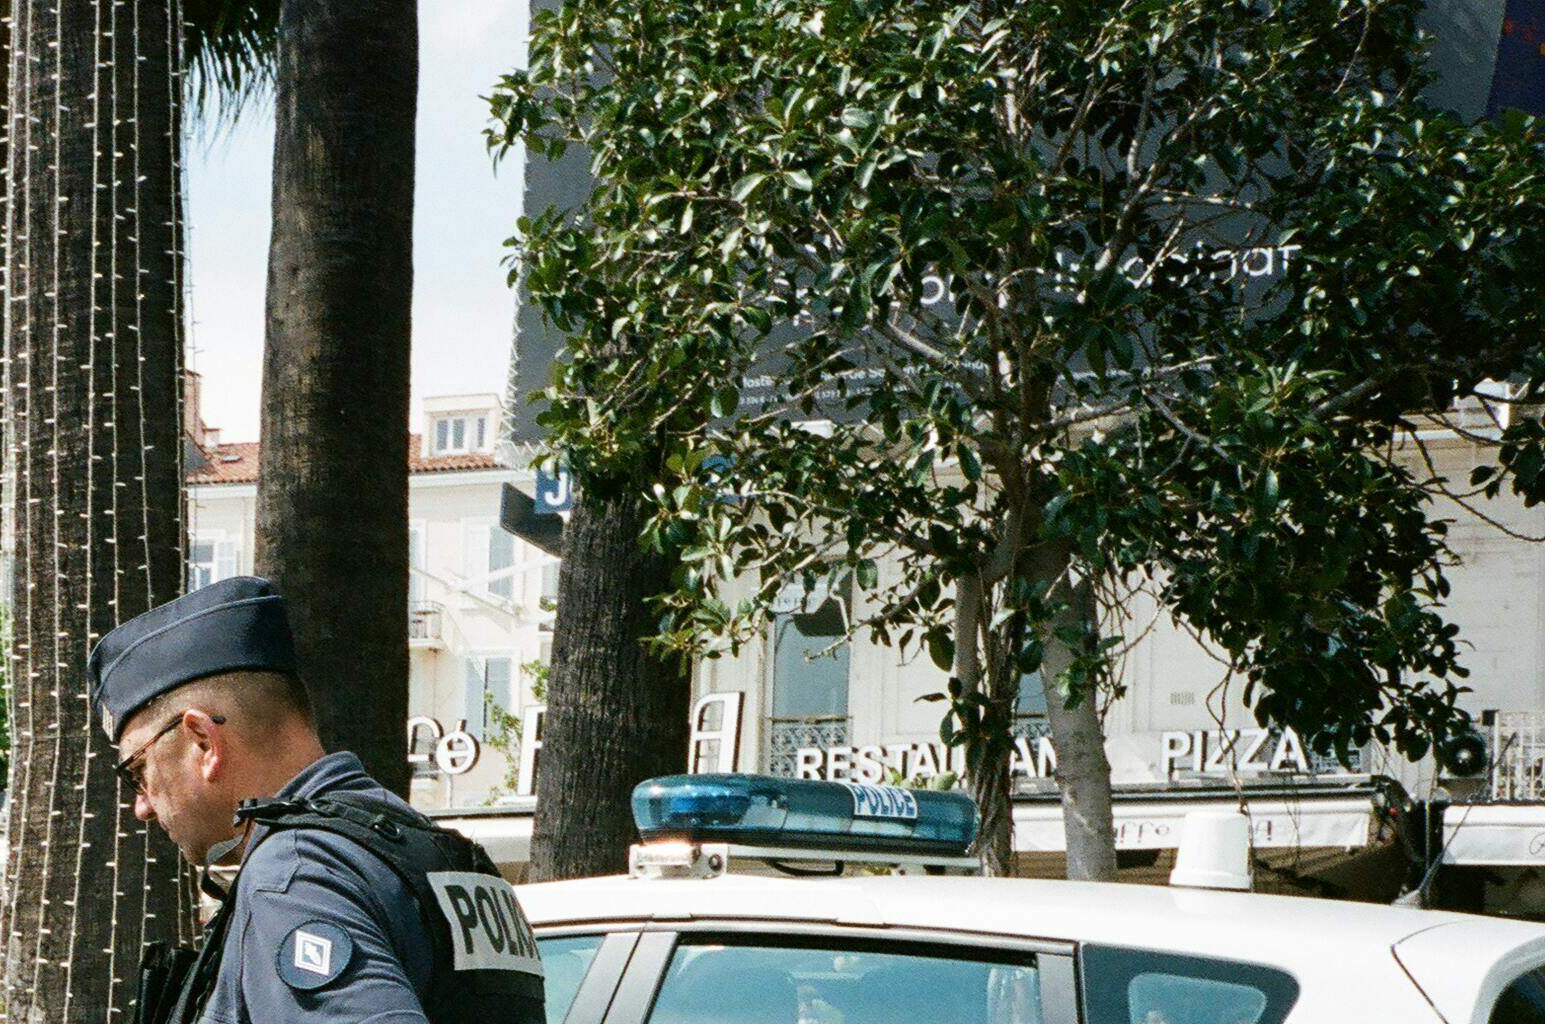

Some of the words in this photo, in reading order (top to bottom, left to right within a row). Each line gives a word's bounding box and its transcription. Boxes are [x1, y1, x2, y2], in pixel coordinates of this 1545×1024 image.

[797, 738, 1057, 784] RESTAUAN
[1162, 726, 1308, 776] PIZZA
[849, 785, 915, 816] POLICE
